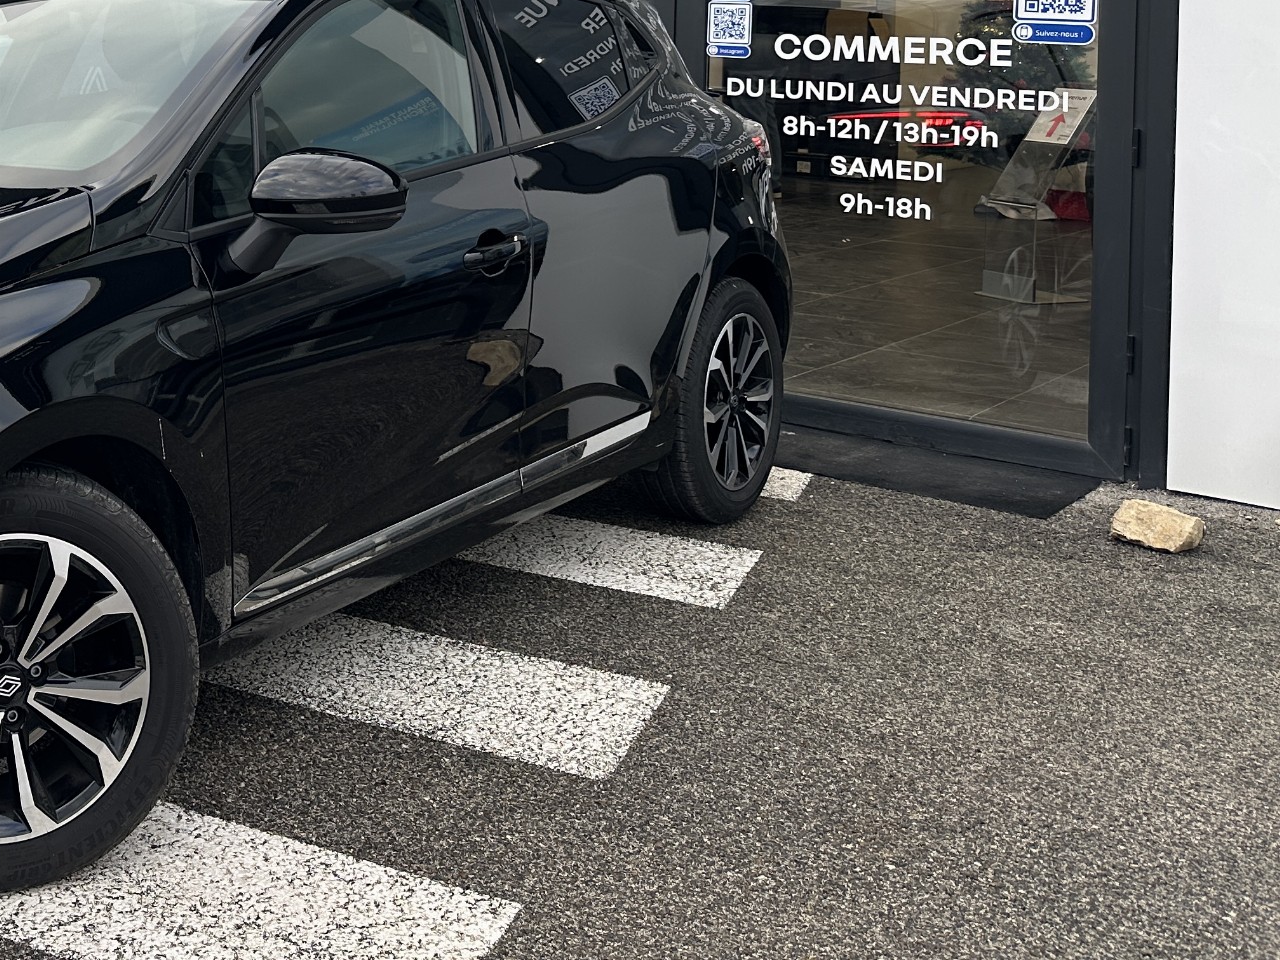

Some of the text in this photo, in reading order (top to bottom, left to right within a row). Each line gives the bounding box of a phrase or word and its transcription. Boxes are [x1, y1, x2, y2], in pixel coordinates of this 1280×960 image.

[1035, 29, 1079, 38] Suivez-nous
[774, 33, 1013, 68] COMMERCE
[726, 77, 1070, 113] DU LUNDI AU VENDREDI
[782, 115, 999, 148] 8h-12h / 13h-19h
[830, 155, 943, 183] SAMEDI
[839, 193, 932, 220] 9h-18h
